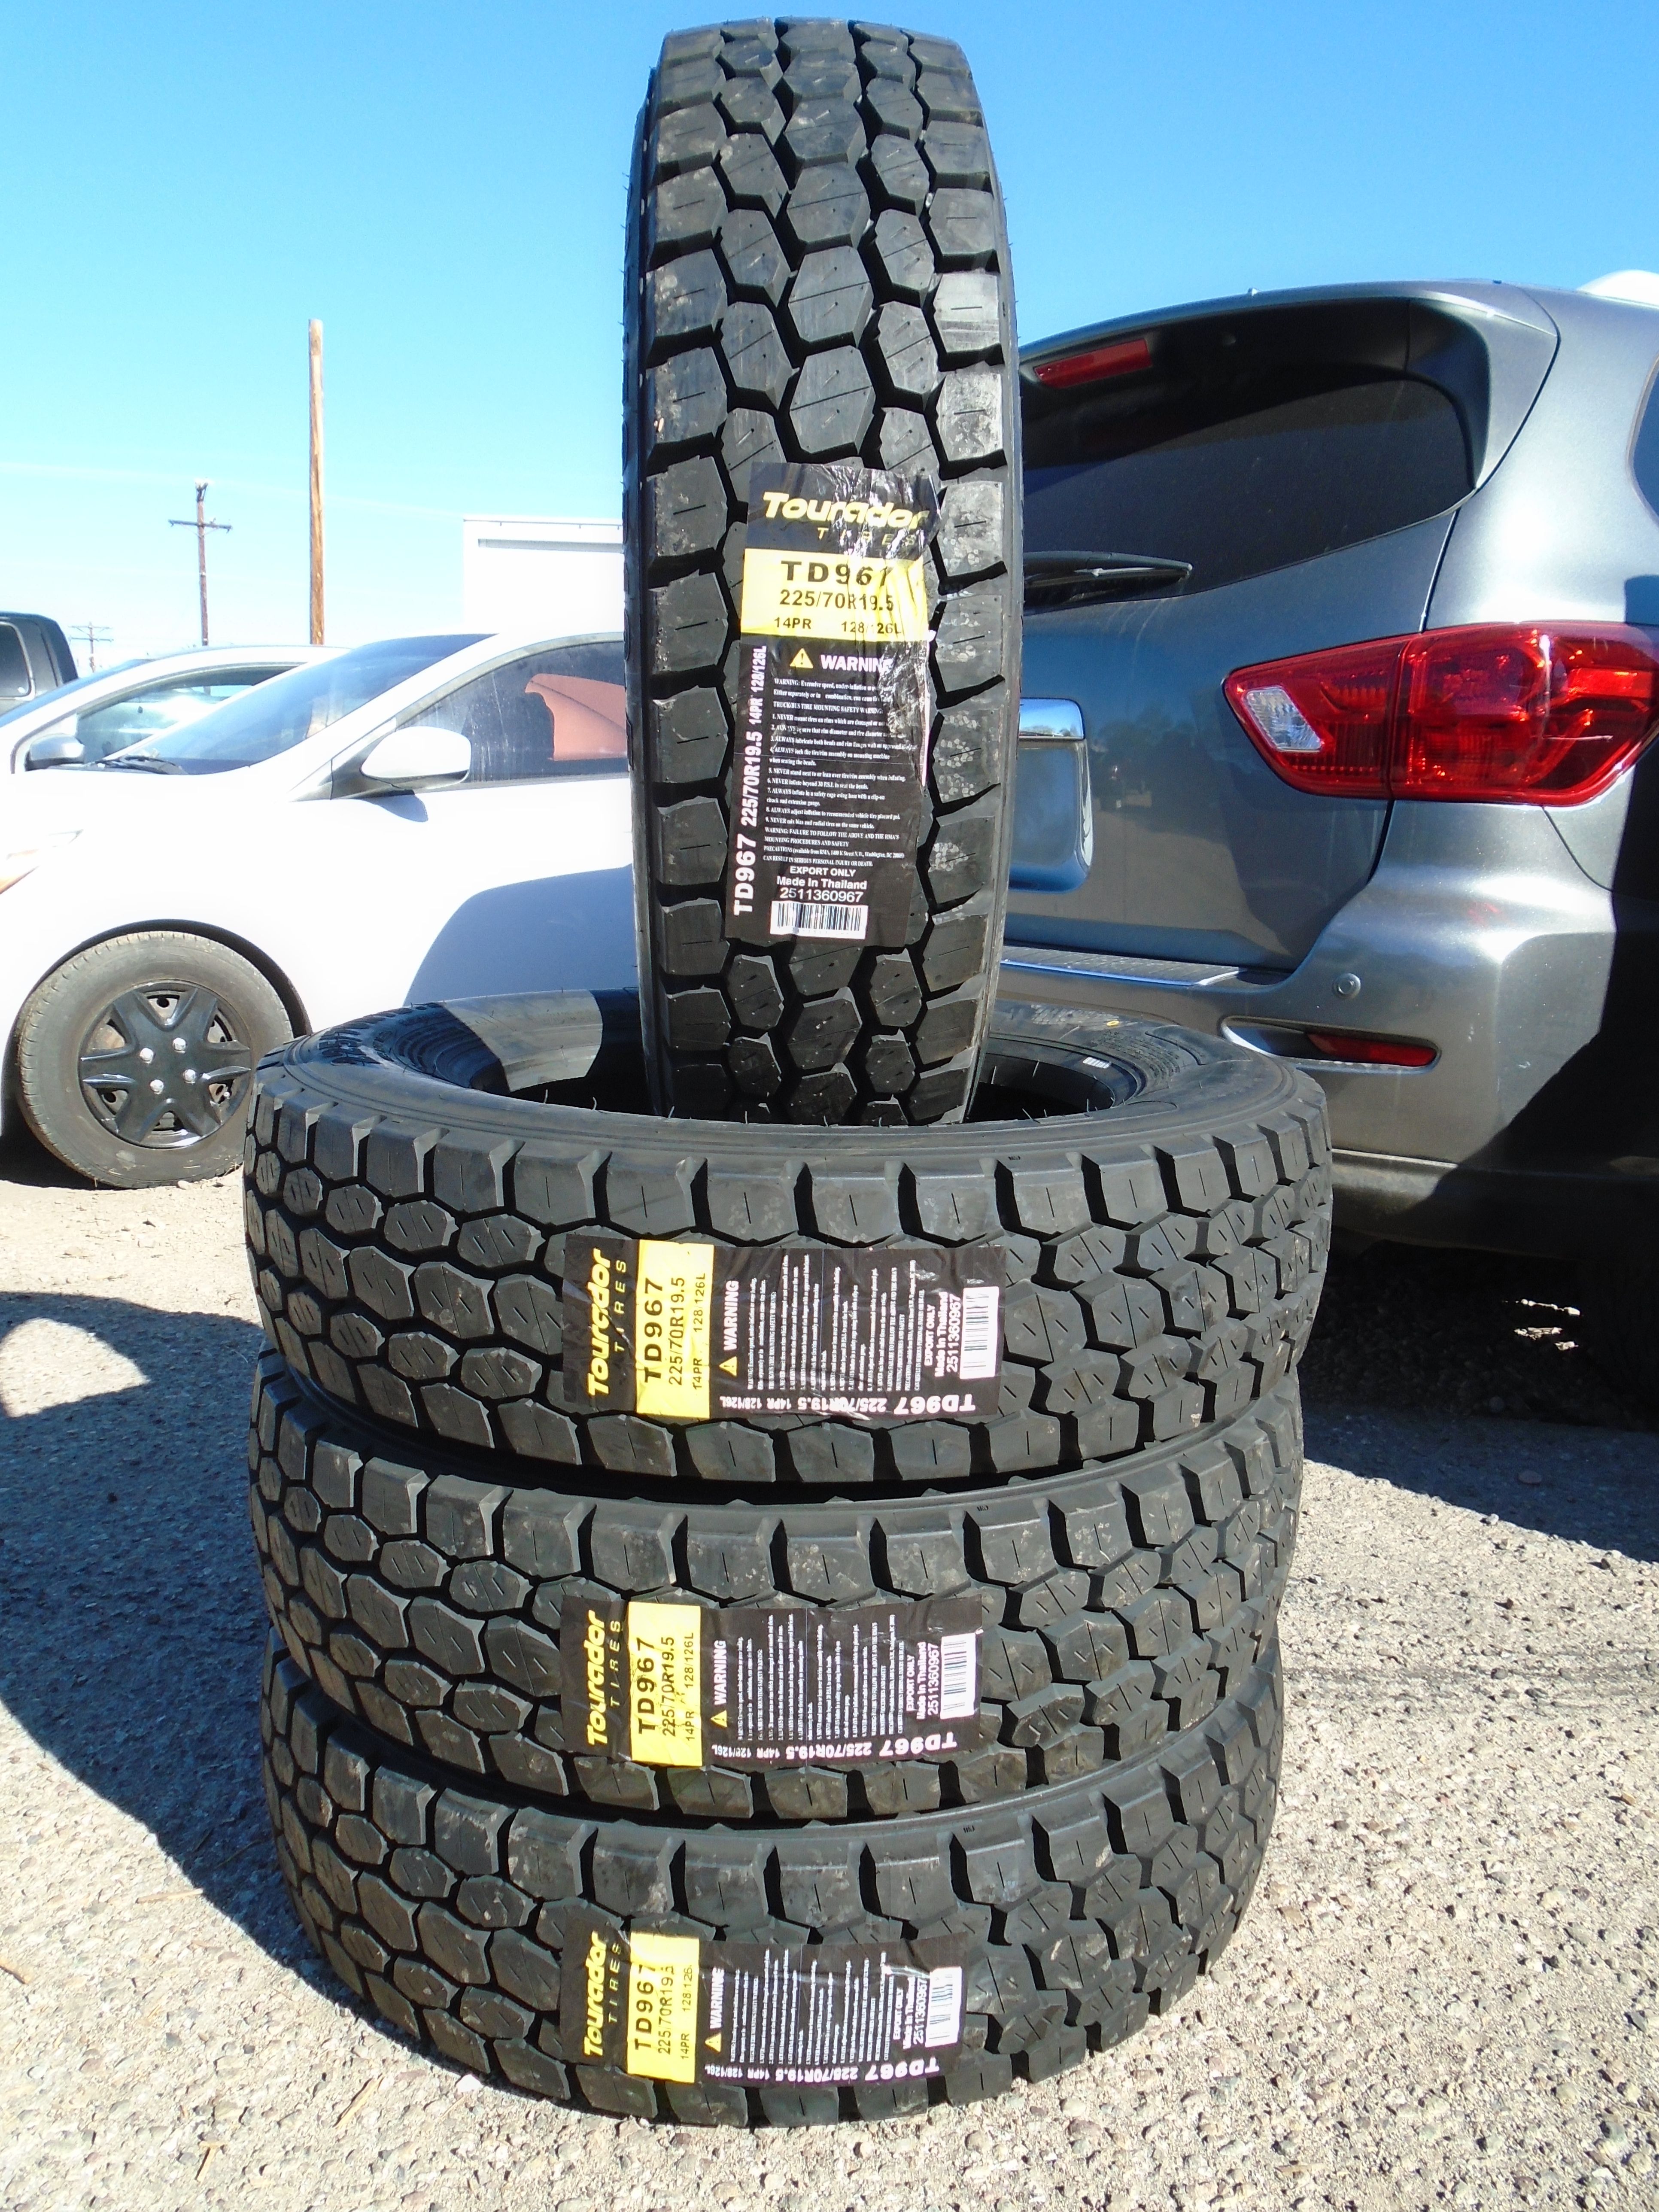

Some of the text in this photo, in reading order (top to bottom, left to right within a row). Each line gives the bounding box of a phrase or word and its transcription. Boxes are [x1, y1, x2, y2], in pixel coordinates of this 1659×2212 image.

[763, 492, 929, 529] Tourador
[817, 527, 915, 546] TIRES
[774, 617, 811, 630] 14PR
[780, 589, 894, 611] 225/70R19.5
[820, 654, 893, 673] WARNING
[733, 646, 767, 916] TD967 225/70R19.5 14PR 128/126L
[776, 876, 867, 890] Made In Thailand
[780, 887, 863, 903] 2511360967
[790, 866, 856, 877] EXPORT ONLY
[586, 1249, 610, 1396] Tourador
[614, 1260, 626, 1352] TIRES
[644, 1277, 662, 1382] TD967
[668, 1278, 685, 1386] 225/70R19.5
[693, 1273, 705, 1390] 14PR 128/126L
[723, 1281, 738, 1350] WARNING
[925, 1305, 935, 1366] EXPORT ONLY
[935, 1292, 948, 1376] Made In Thailand
[947, 1294, 960, 1372] 2511360967
[720, 1394, 975, 1413] TD967 225/70R19.5 14PR 128/126L
[583, 1610, 608, 1745] Tourador
[610, 1621, 620, 1707] TIRES
[637, 1637, 655, 1734] TD967
[661, 1637, 675, 1736] 225/70R19.5
[684, 1633, 695, 1741] 14PR 128/126L
[714, 1640, 727, 1705] WARNING
[906, 1655, 915, 1711] EXPORT ONLY
[917, 1642, 927, 1683] Thailand
[927, 1644, 939, 1716] 2511360967
[916, 1695, 926, 1719] Made
[711, 1731, 957, 1760] TD967 225/70R19.5 14PR 128/126L
[584, 1931, 606, 2056] Tourador
[609, 1942, 621, 2023] TIRES
[634, 1964, 656, 2050] TD967
[681, 1965, 693, 2059] 14PR 128/126
[710, 1967, 724, 2028] WARNING
[893, 1988, 904, 2040] EXPORT ONLY
[905, 1977, 915, 2014] Thailand
[914, 1978, 927, 2044] 2511360967
[866, 2057, 939, 2080] TD967
[903, 2026, 913, 2048] Made
[747, 2067, 769, 2081] 14PR
[776, 2066, 858, 2082] 225/70R19.5
